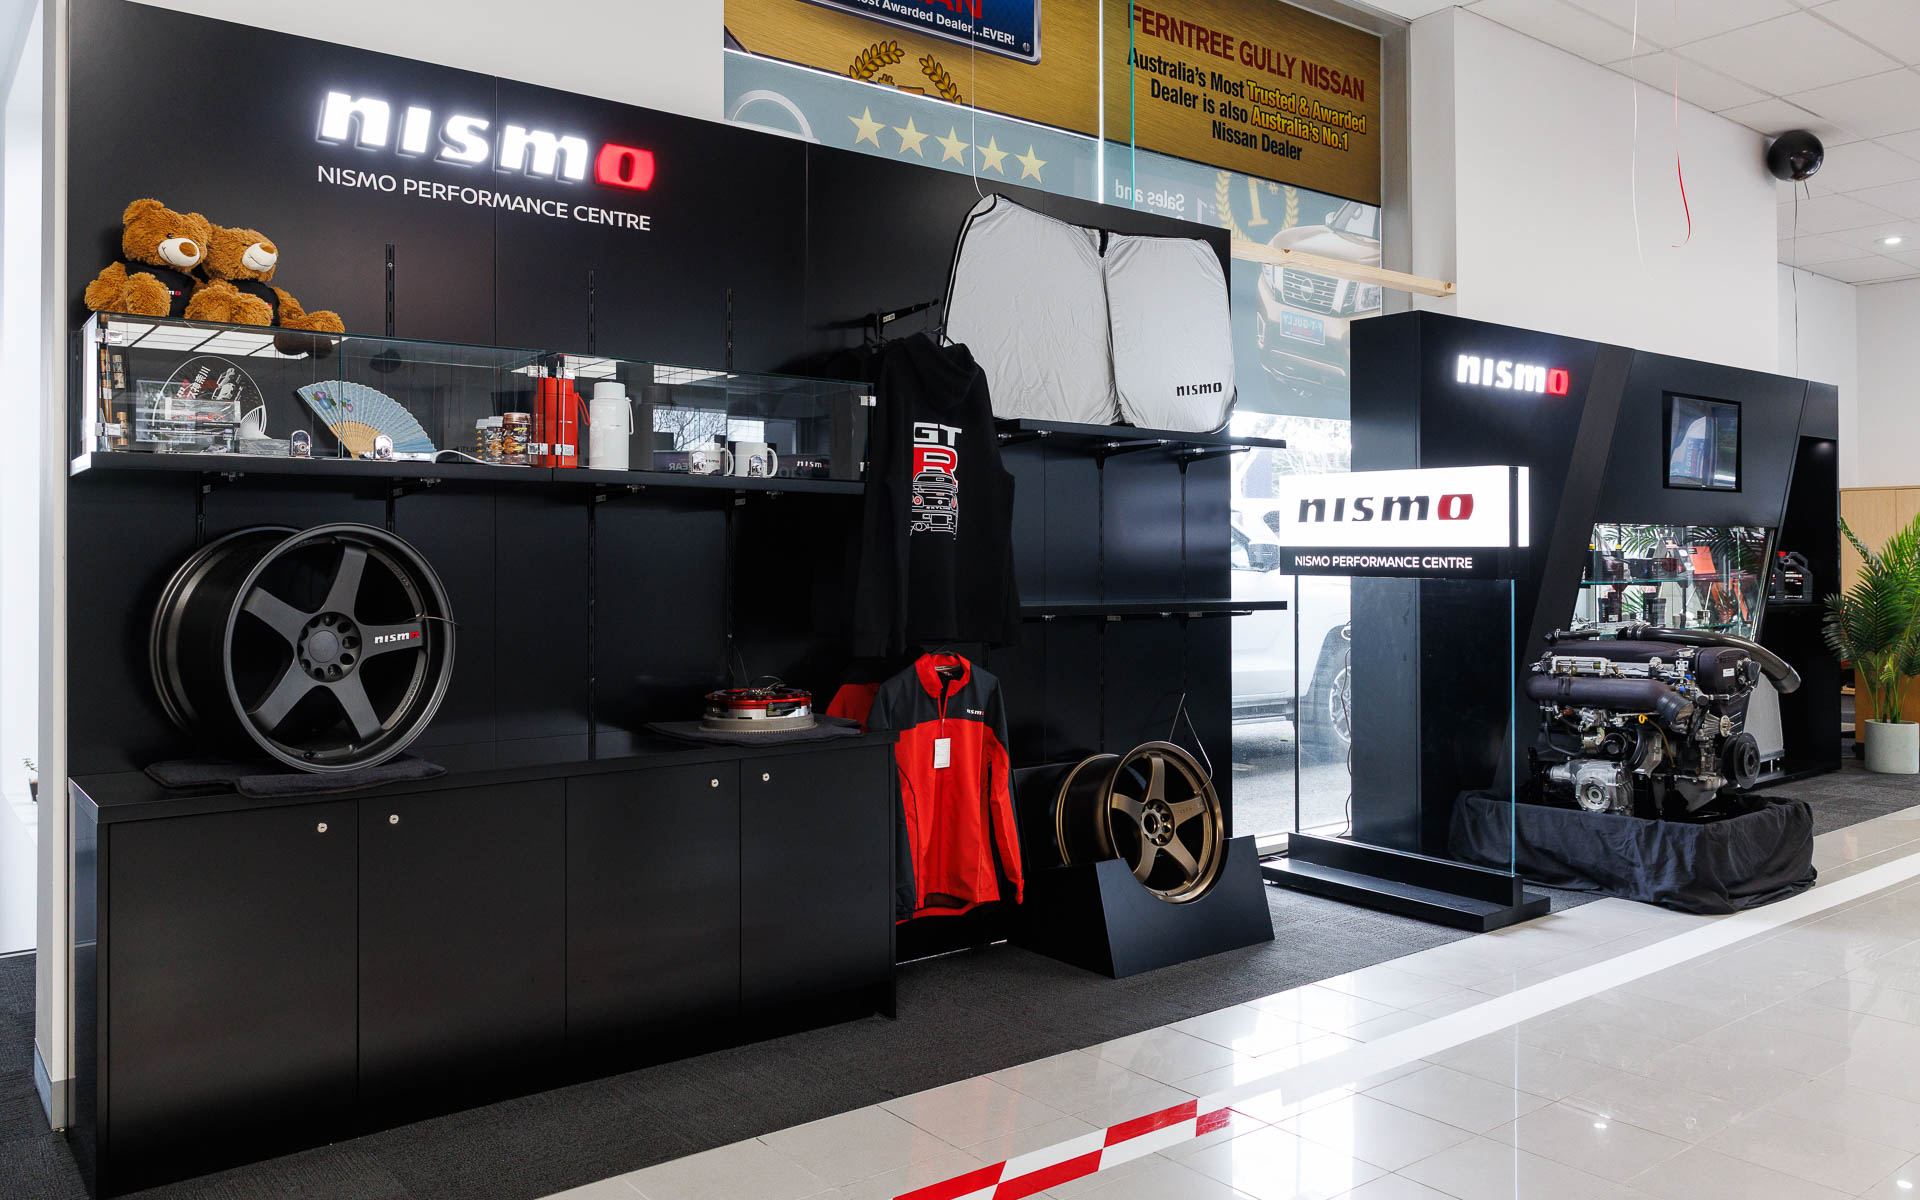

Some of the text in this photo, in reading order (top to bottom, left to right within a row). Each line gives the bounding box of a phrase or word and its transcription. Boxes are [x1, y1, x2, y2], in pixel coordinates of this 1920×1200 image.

[882, 0, 934, 22] Awarded
[1128, 4, 1365, 102] FERNTREE GULLY NISSAN
[1151, 79, 1349, 152] Dealer is also Australia’s No.1
[1210, 71, 1245, 99] Most
[1247, 80, 1297, 115] Trusted
[1298, 96, 1310, 118] &
[1311, 101, 1367, 134] Awarded
[319, 91, 656, 190] nismo
[1212, 119, 1303, 161] Nissan Dealer
[317, 165, 651, 231] NISMO PERFORMANCE CENTRE
[1176, 382, 1222, 397] nismo
[1457, 355, 1570, 395] nismo
[913, 422, 962, 446] GT
[1298, 493, 1474, 523] nismo
[1295, 555, 1472, 569] NISMO PERFORMANCE CENTRE
[374, 631, 419, 644] nismo
